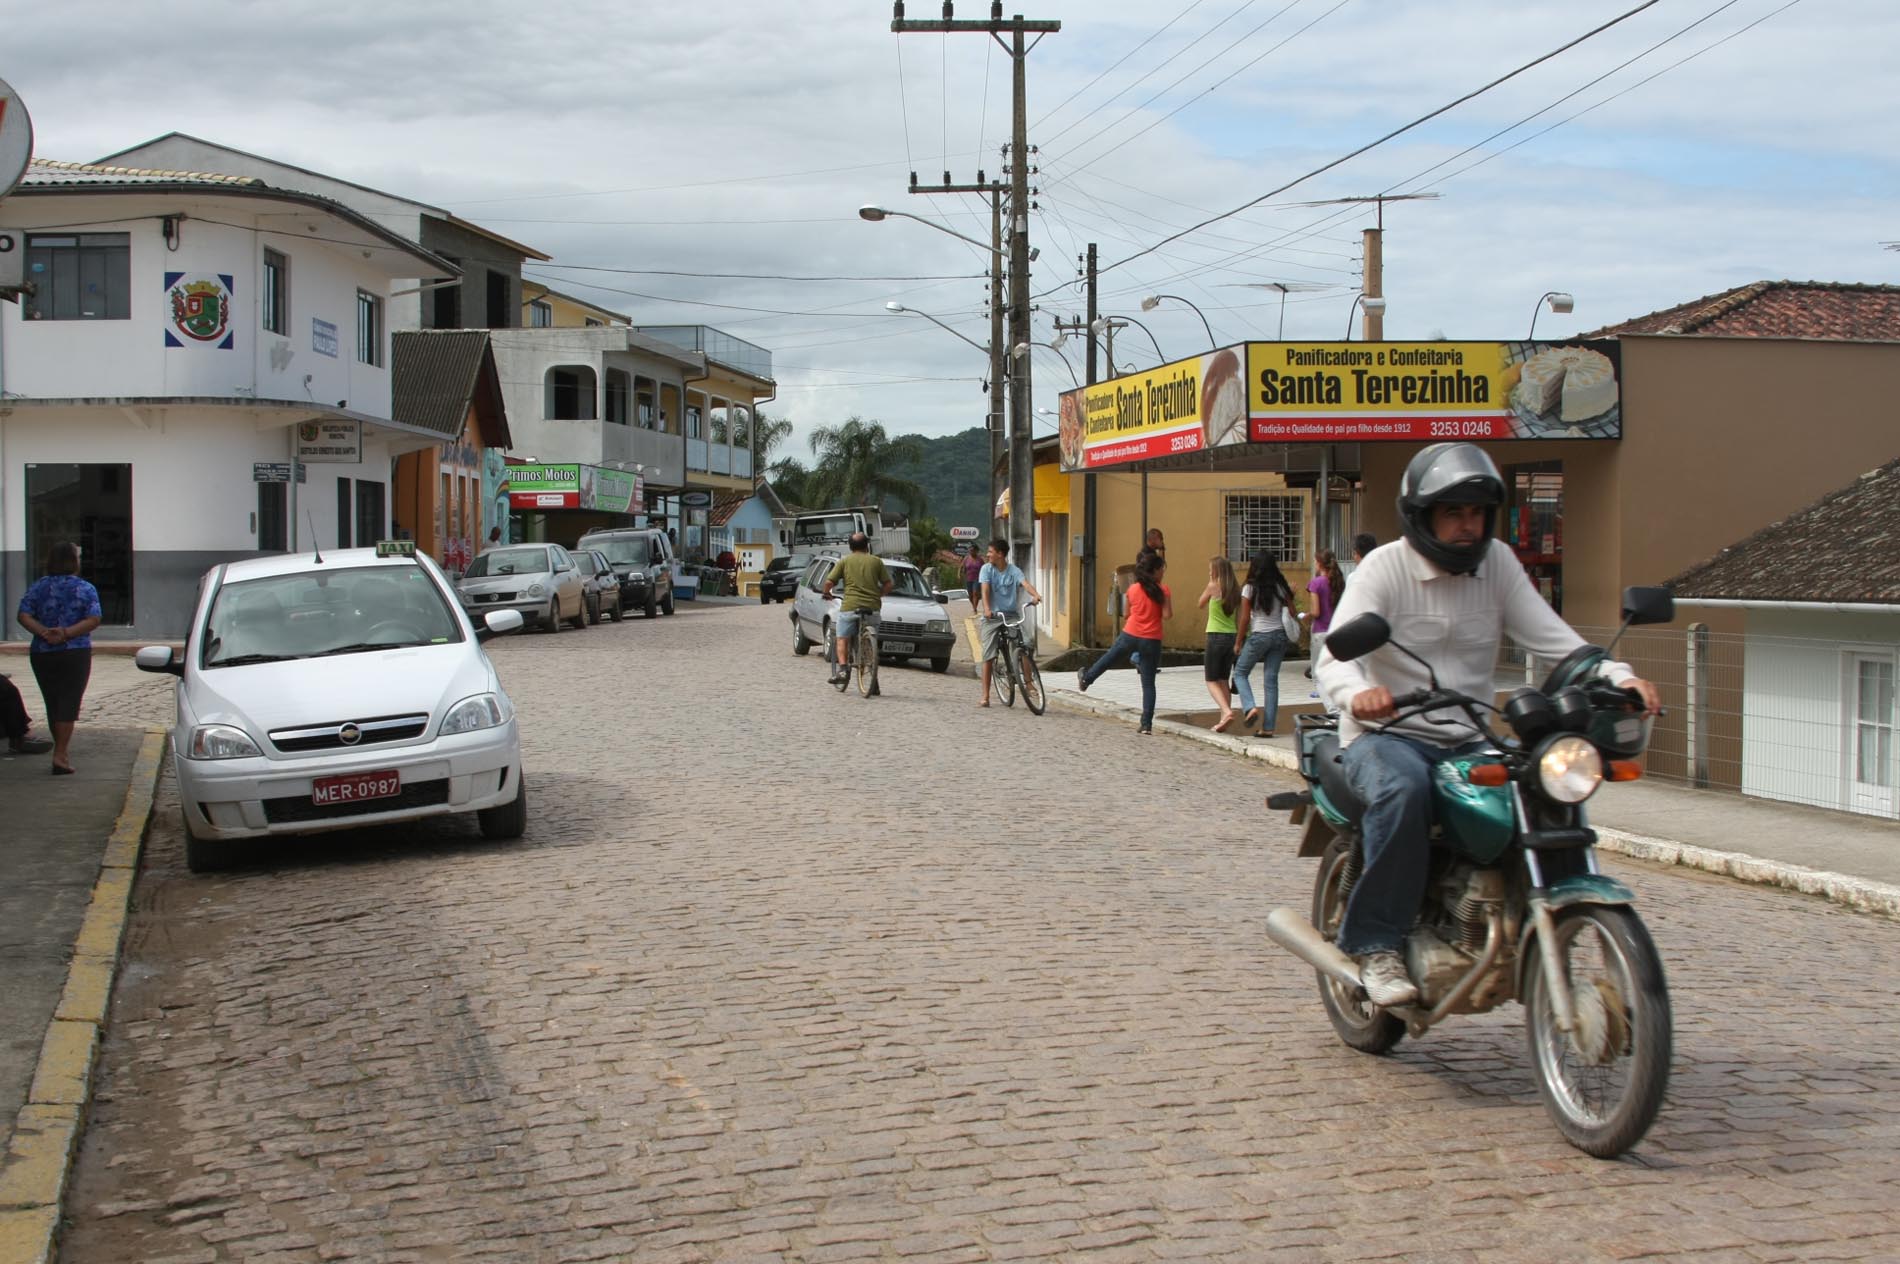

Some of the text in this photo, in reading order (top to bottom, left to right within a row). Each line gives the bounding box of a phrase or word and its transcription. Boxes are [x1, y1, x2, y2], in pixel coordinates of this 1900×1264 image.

[1286, 348, 1463, 366] Panificadora e Confeitaria
[1260, 369, 1489, 404] Santa Terezinha
[1116, 369, 1196, 431] Santa Terezinha
[1258, 424, 1285, 434] Tradição
[1292, 424, 1324, 435] Qualidade
[1325, 424, 1334, 433] de
[1335, 424, 1345, 435] pai
[1346, 426, 1357, 435] pra
[1358, 423, 1372, 433] filho
[1373, 423, 1392, 433] desde
[1394, 423, 1411, 433] 1912
[1430, 421, 1492, 436] 3253 0246
[1171, 433, 1198, 451] 3253 0246
[506, 467, 576, 481] Primos Motos
[380, 543, 413, 553] TAXI
